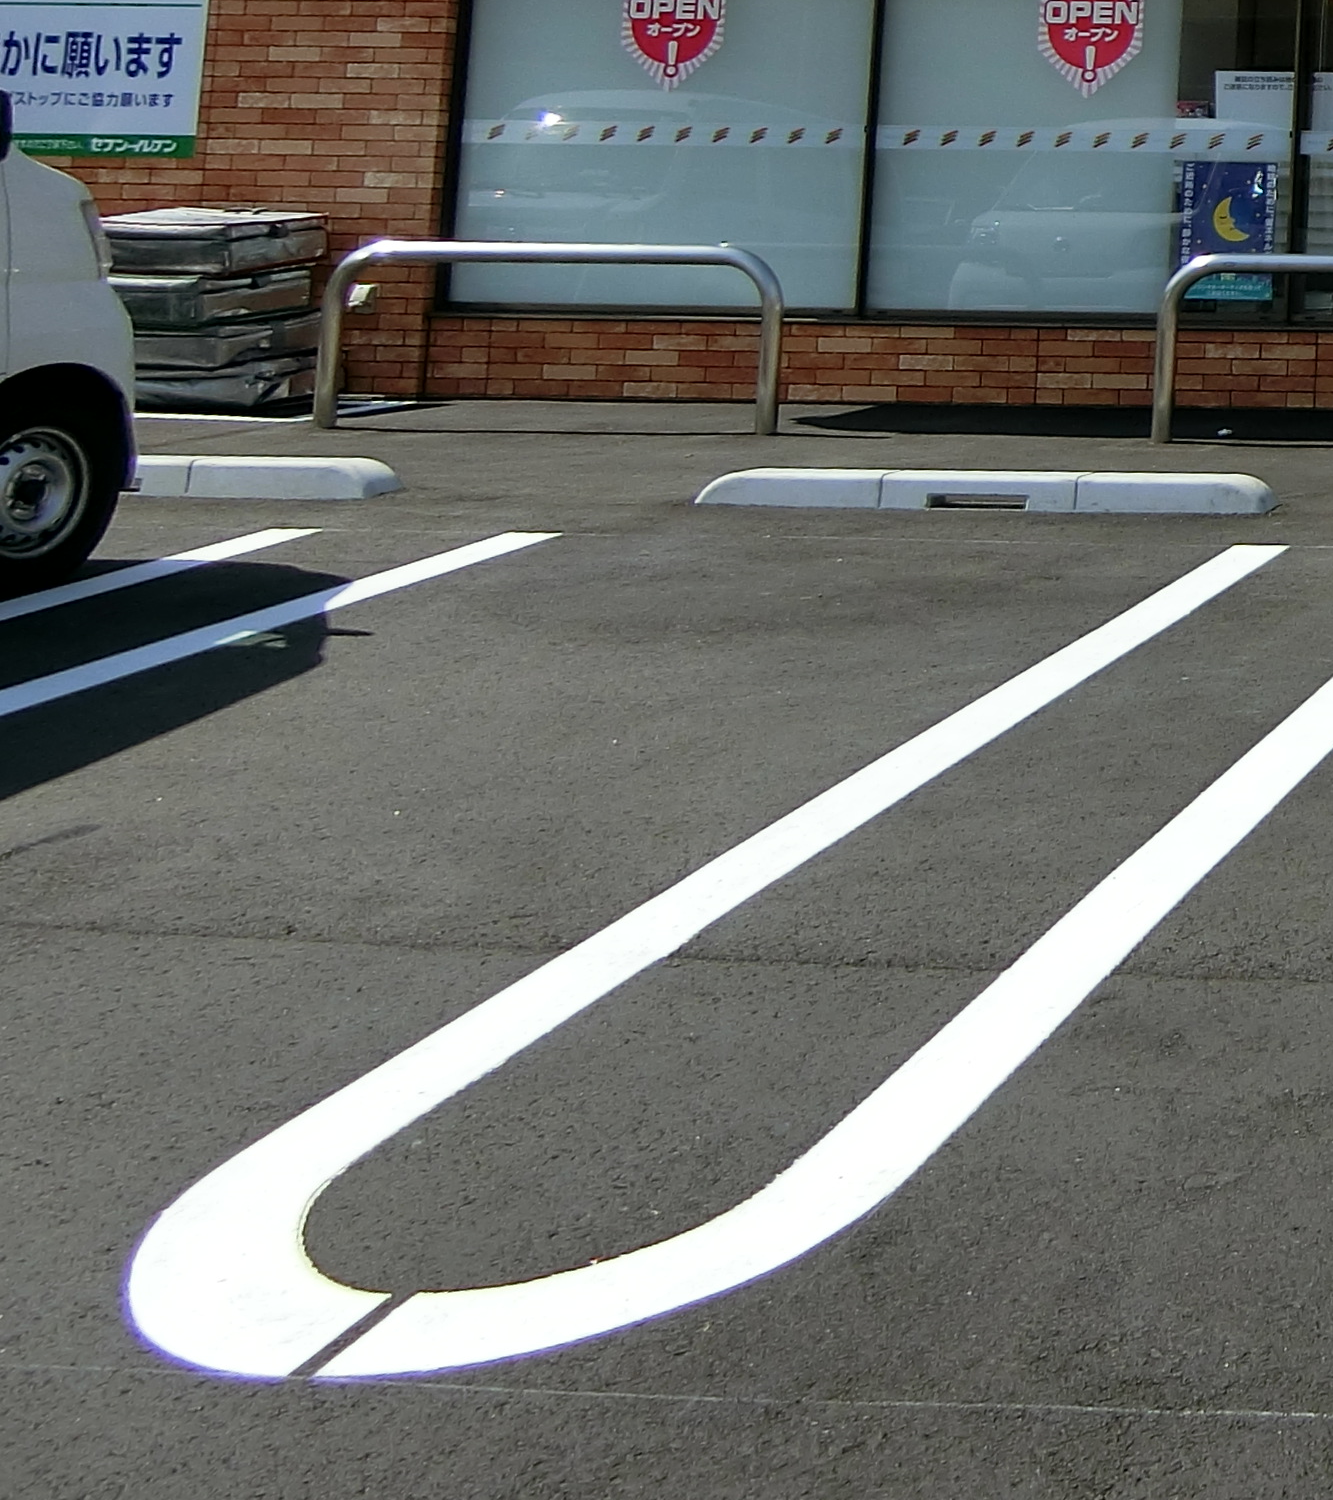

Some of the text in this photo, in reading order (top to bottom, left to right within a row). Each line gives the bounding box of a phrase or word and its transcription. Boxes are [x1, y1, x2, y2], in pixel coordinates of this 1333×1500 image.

[1044, 0, 1139, 24] OPEN
[646, 22, 701, 37] オープン
[1064, 27, 1119, 41] オープン
[0, 31, 182, 78] かに願います
